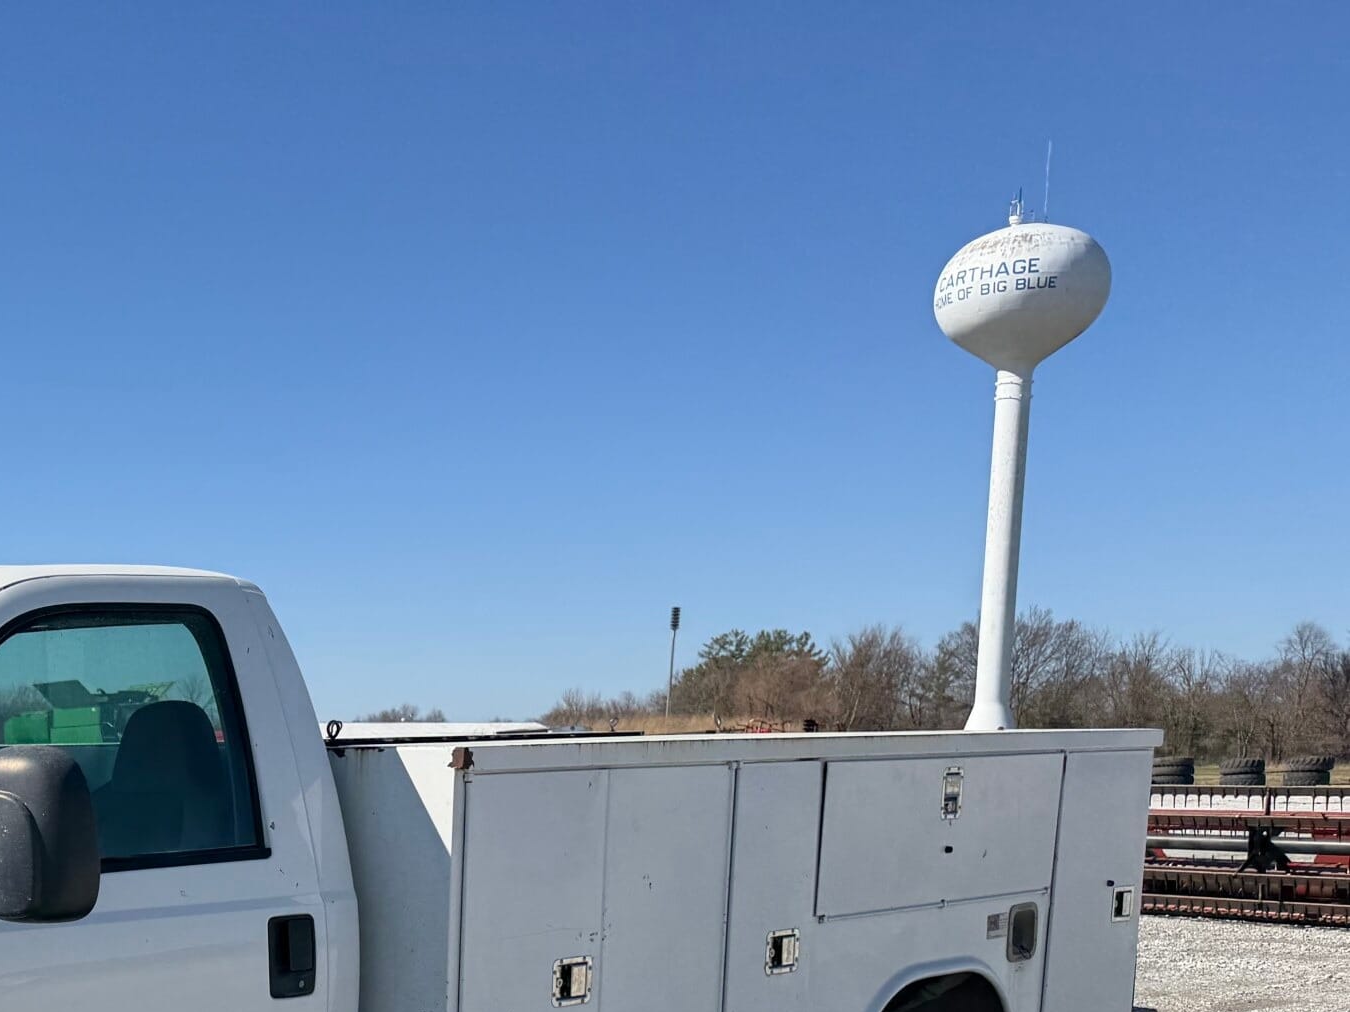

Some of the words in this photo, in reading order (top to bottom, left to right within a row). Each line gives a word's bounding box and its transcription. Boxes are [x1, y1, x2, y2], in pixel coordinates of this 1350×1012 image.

[939, 257, 1041, 292] CARTHAGE
[957, 286, 973, 301] OF
[980, 279, 1007, 296] BIG
[1015, 276, 1058, 291] BLUE
